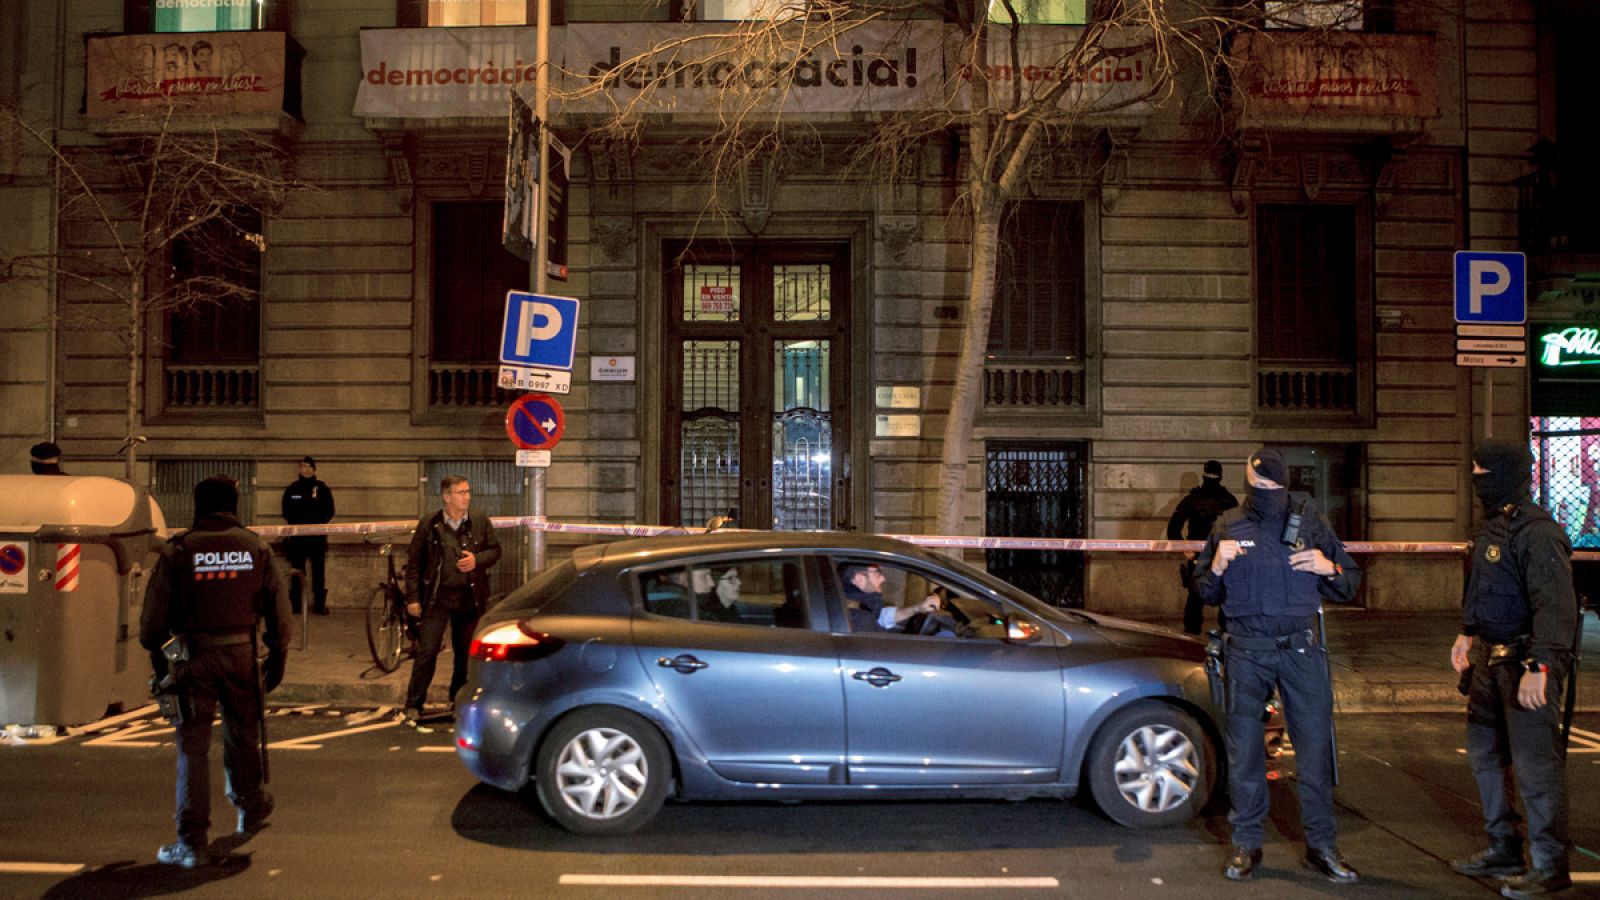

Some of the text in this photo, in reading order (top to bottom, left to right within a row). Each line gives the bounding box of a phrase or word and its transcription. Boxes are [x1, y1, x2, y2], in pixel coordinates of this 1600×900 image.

[1469, 260, 1511, 314] P
[515, 301, 563, 357] P
[528, 380, 550, 388] 0997
[195, 551, 253, 565] POLICIA
